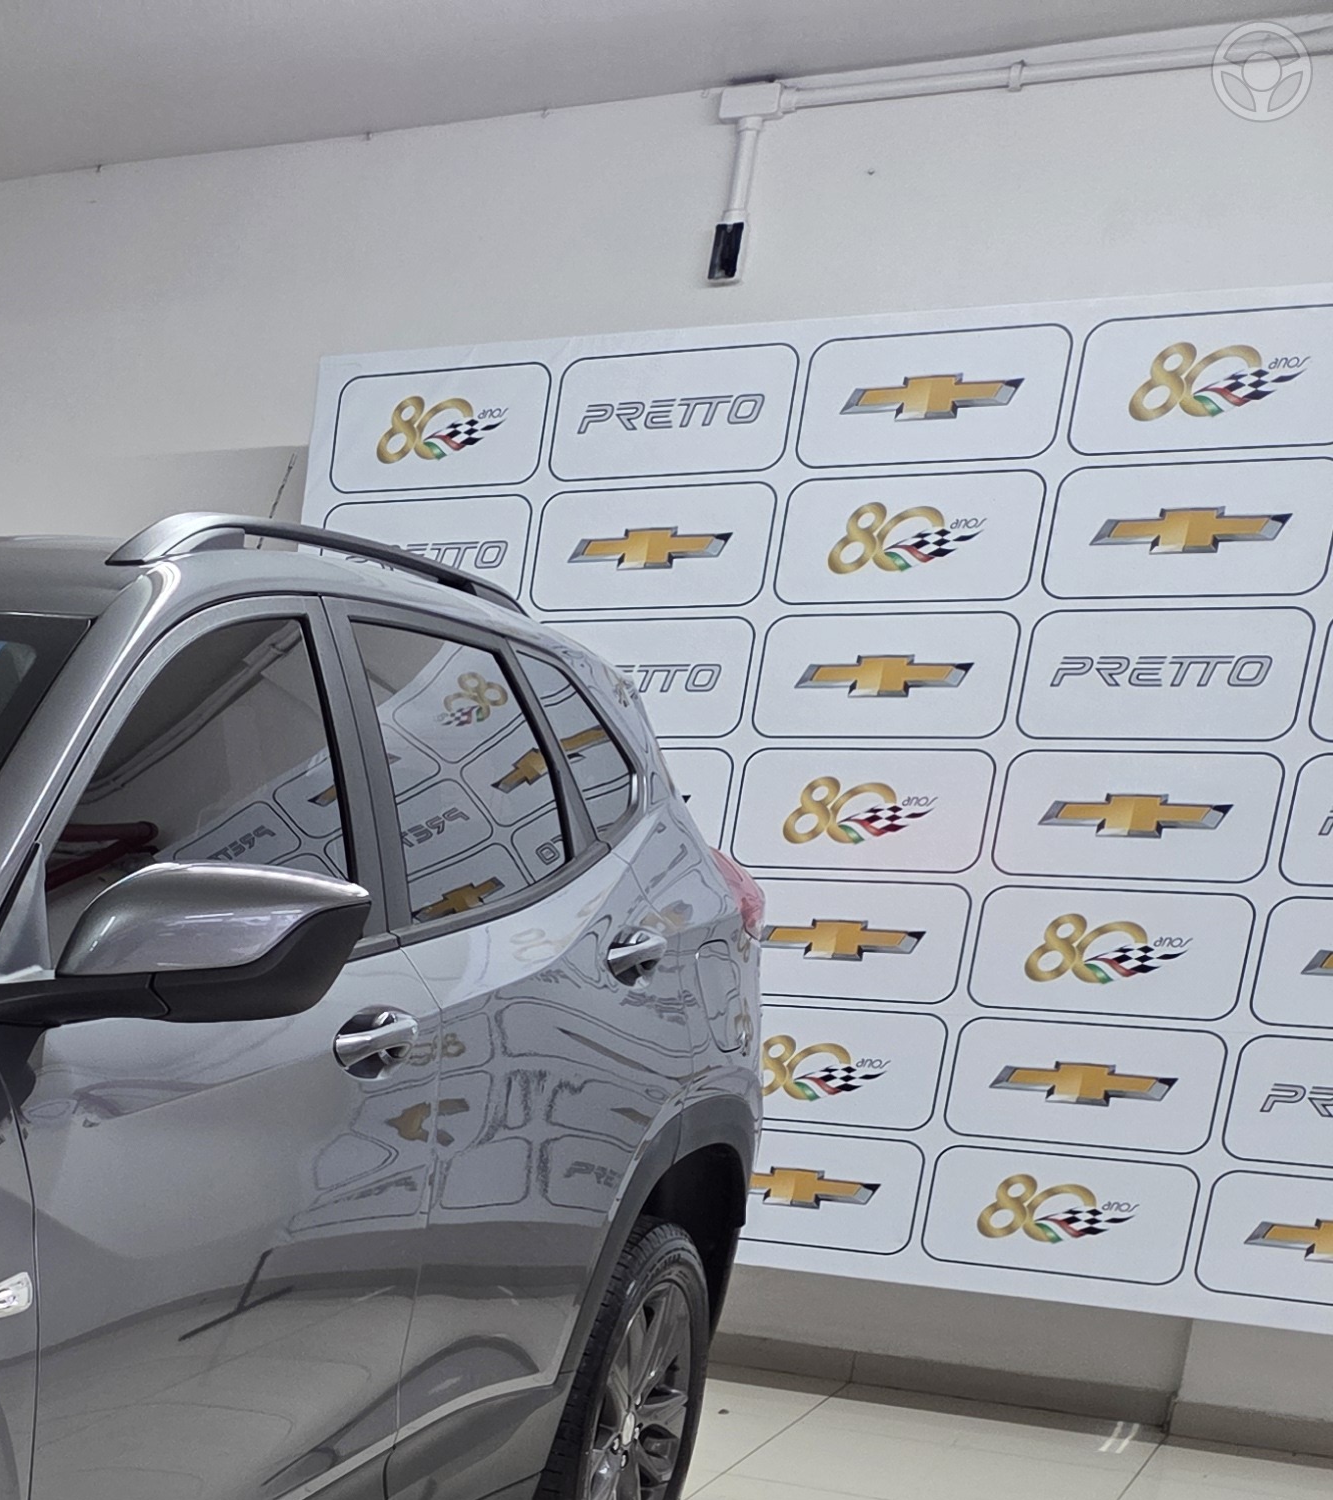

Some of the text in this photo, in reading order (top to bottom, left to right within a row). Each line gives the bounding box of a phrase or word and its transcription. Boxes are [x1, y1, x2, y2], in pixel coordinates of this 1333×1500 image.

[576, 393, 766, 435] PRETTO
[1128, 341, 1312, 422] 80 anos
[376, 395, 509, 464] 80 anos
[827, 501, 988, 575] 80 anos
[1050, 654, 1273, 688] PRETTO
[782, 776, 939, 845] 80 anos
[1024, 912, 1194, 984] 80 anos
[855, 1056, 892, 1070] anos
[976, 1173, 1140, 1243] 80 anos
